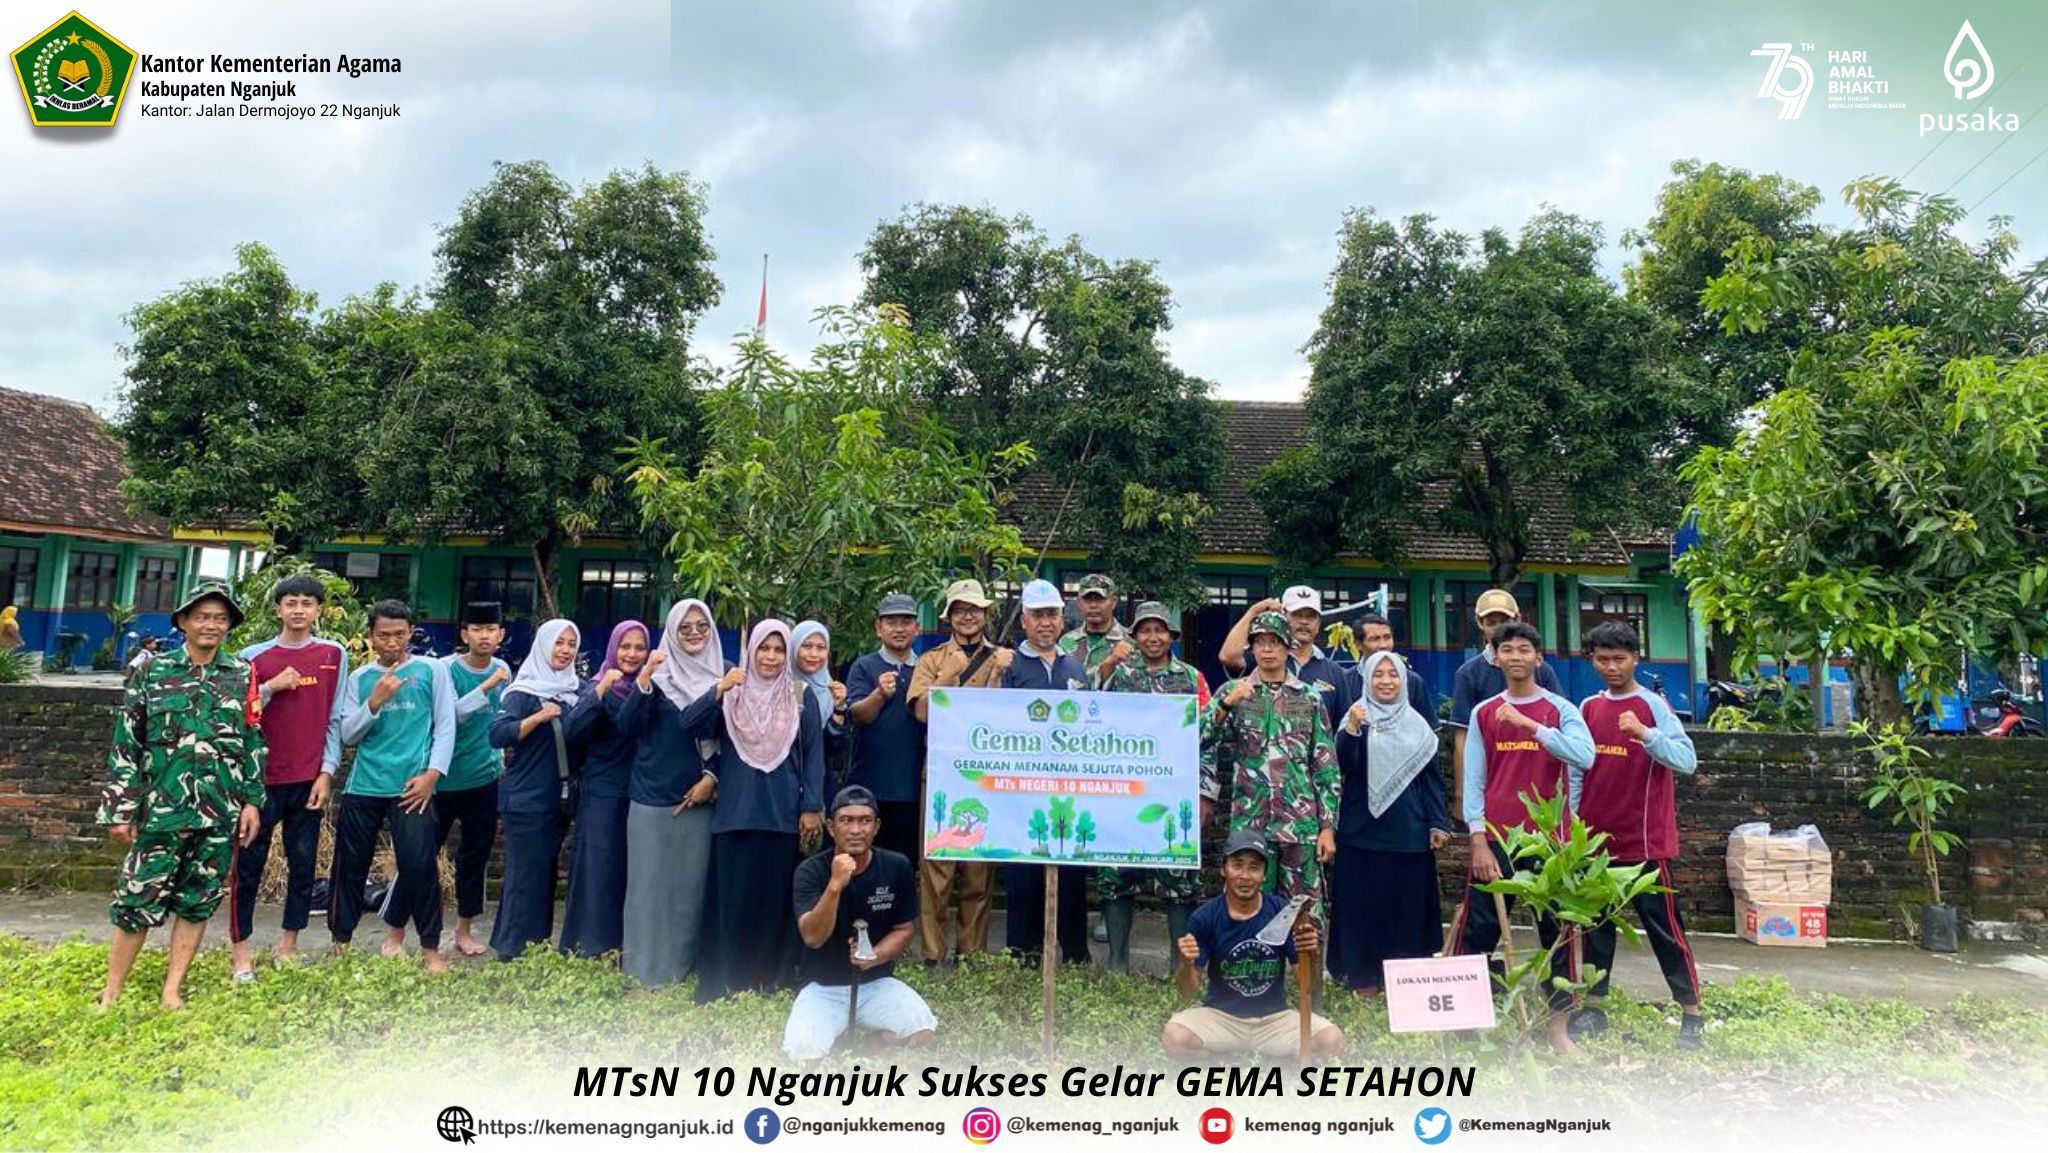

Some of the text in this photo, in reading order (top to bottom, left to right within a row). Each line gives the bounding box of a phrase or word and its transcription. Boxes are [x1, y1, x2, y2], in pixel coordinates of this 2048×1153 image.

[971, 727, 1156, 757] Gema Setahon
[953, 759, 1174, 777] GERAKAN MENANAM SEJUTA POHON
[994, 778, 1131, 794] MTs NEGERI 10 NGANJUK
[1805, 919, 1821, 928] 48
[1397, 974, 1479, 985] LOKASI MENANAM
[1428, 994, 1455, 1012] 8E
